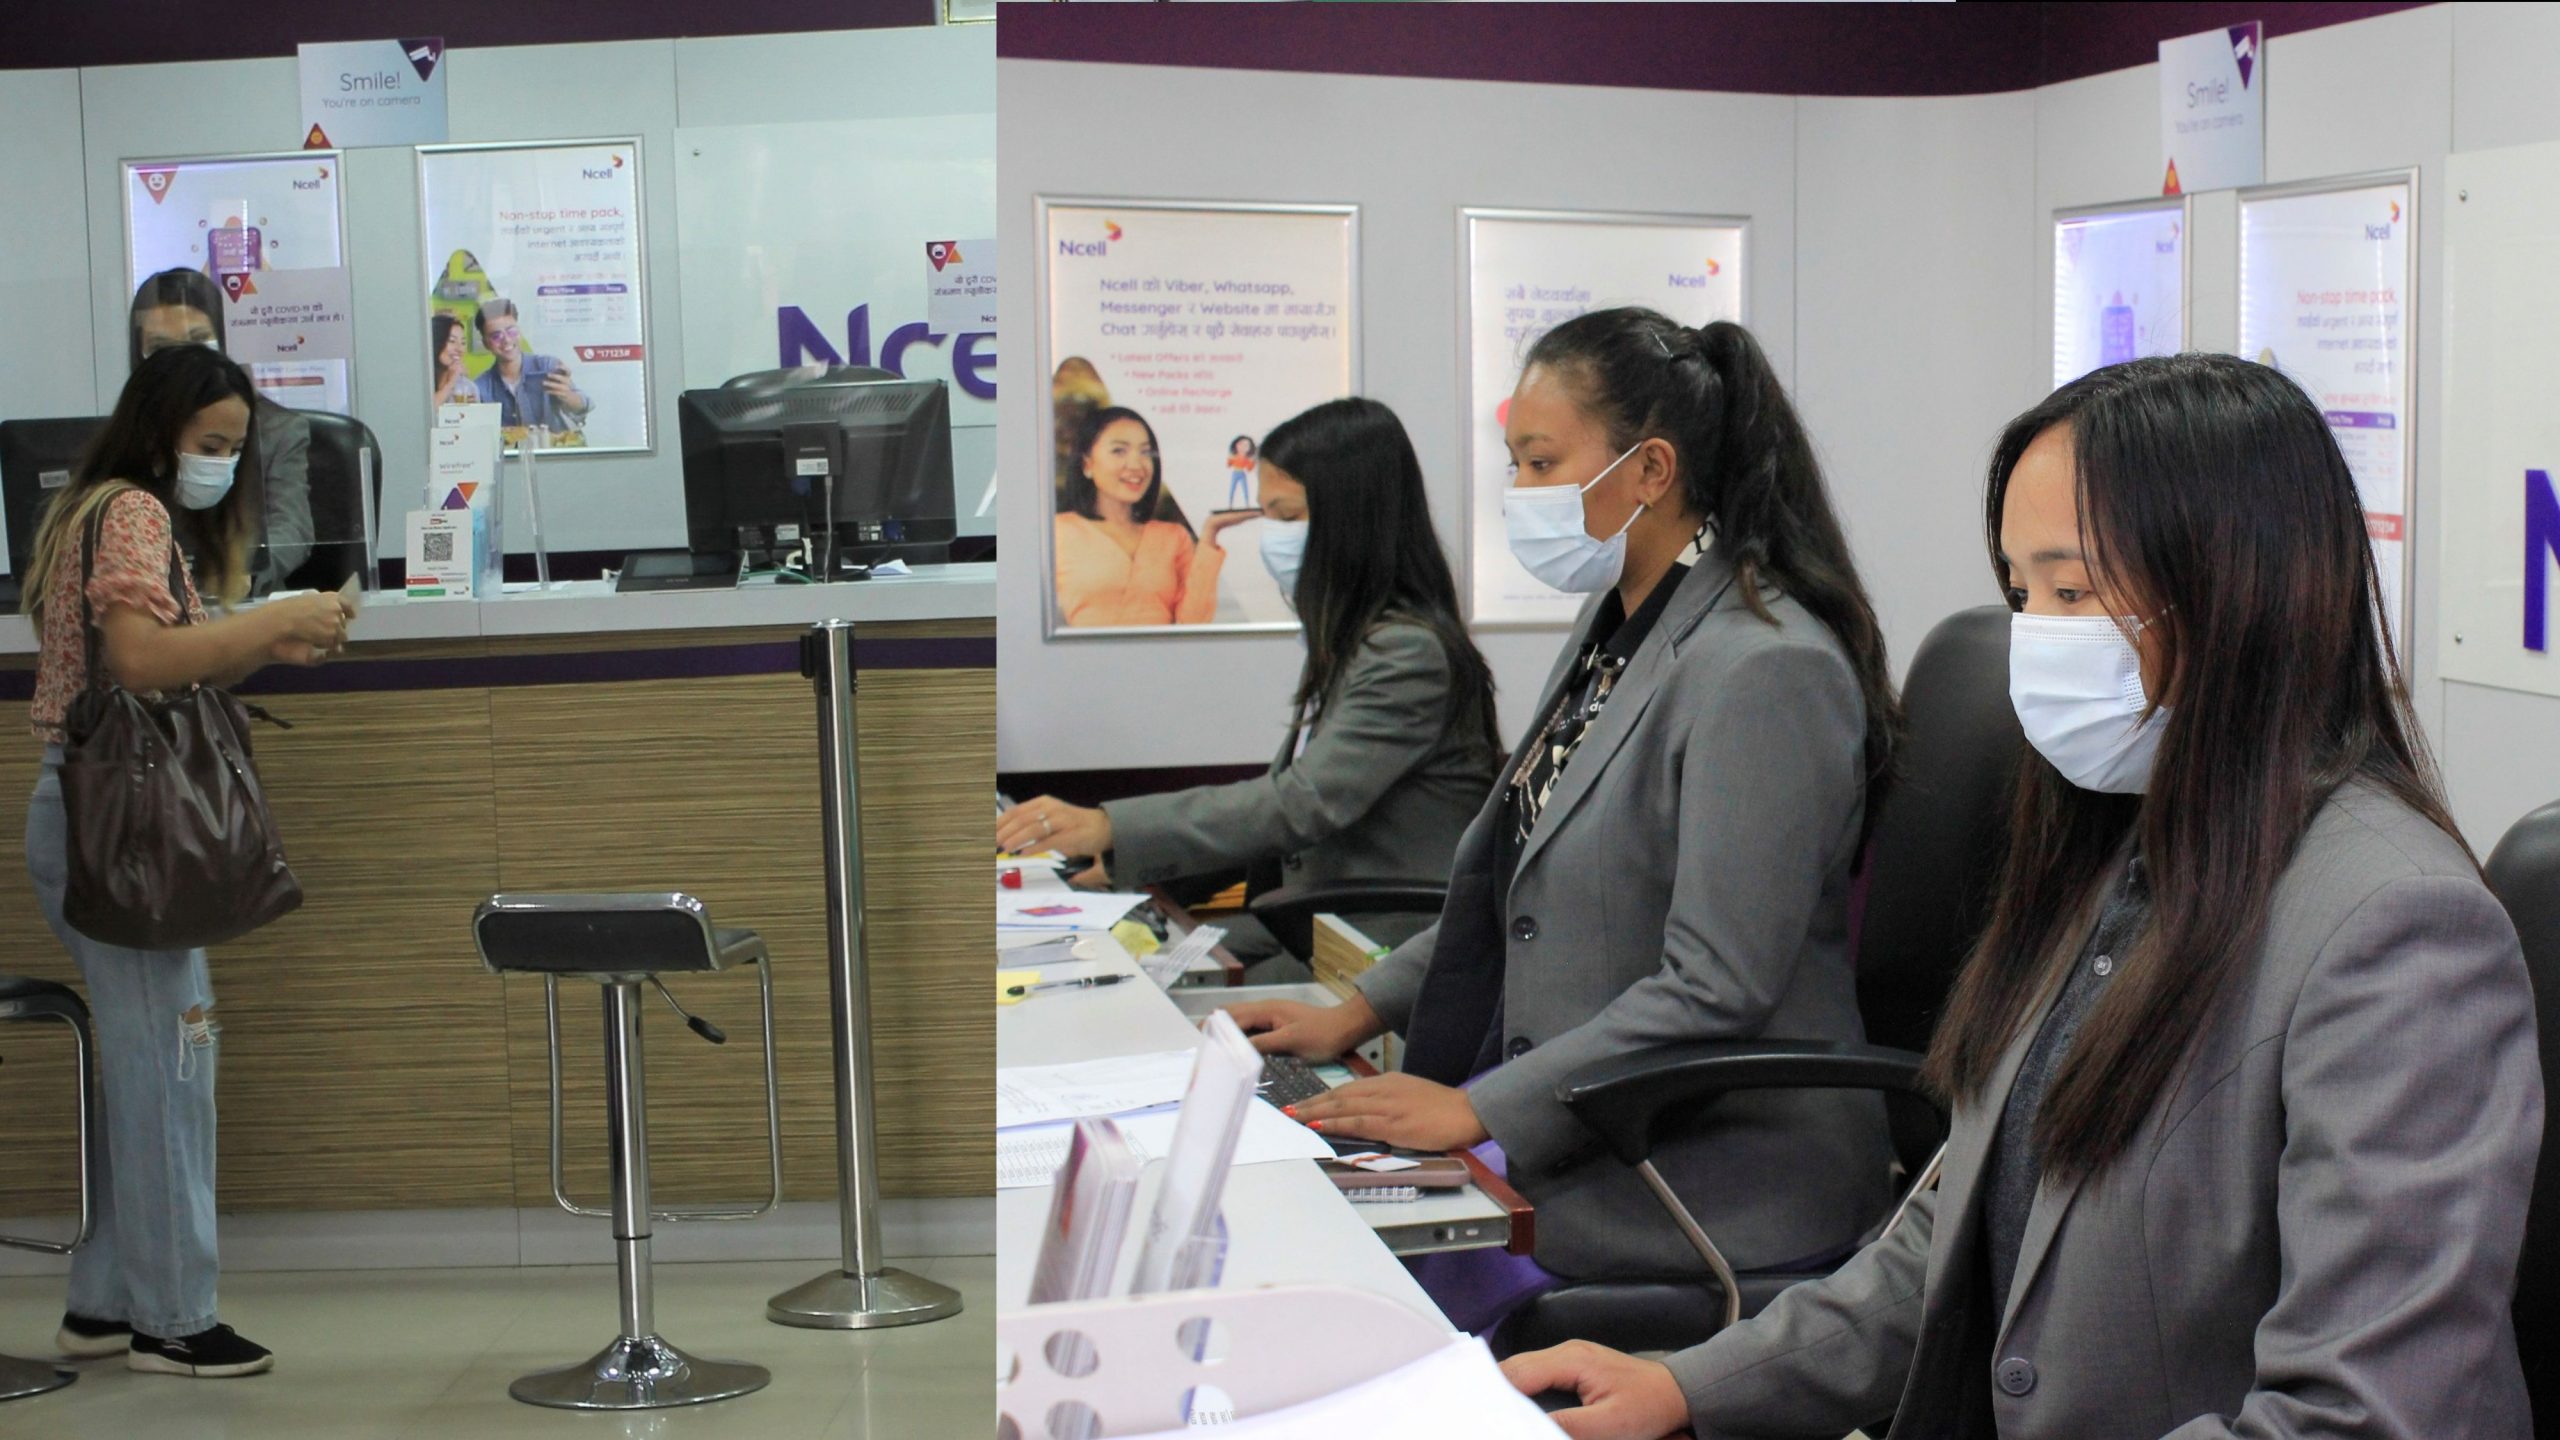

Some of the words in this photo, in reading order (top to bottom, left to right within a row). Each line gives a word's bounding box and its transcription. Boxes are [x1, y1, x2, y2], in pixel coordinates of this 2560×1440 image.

[340, 71, 401, 91] Smile!
[2186, 76, 2230, 108] Smile!
[323, 97, 357, 109] You're
[360, 98, 374, 107] on
[378, 95, 421, 107] camera
[582, 168, 613, 180] Ncell
[293, 180, 321, 190] Ncell
[499, 210, 557, 222] Non-stop
[560, 208, 587, 219] time
[2364, 223, 2391, 240] Ncell
[527, 239, 567, 248] internet
[1058, 240, 1107, 257] Ncell
[1100, 279, 1138, 291] Ncell
[1165, 279, 1209, 295] Viber,
[1214, 280, 1295, 296] Whatsapp,
[1668, 274, 1706, 288] Ncell
[1100, 302, 1183, 318] Messenger
[1200, 303, 1261, 315] Website
[1100, 322, 1136, 336] Chat
[277, 343, 298, 353] Ncell
[1182, 387, 1233, 399] Recharge
